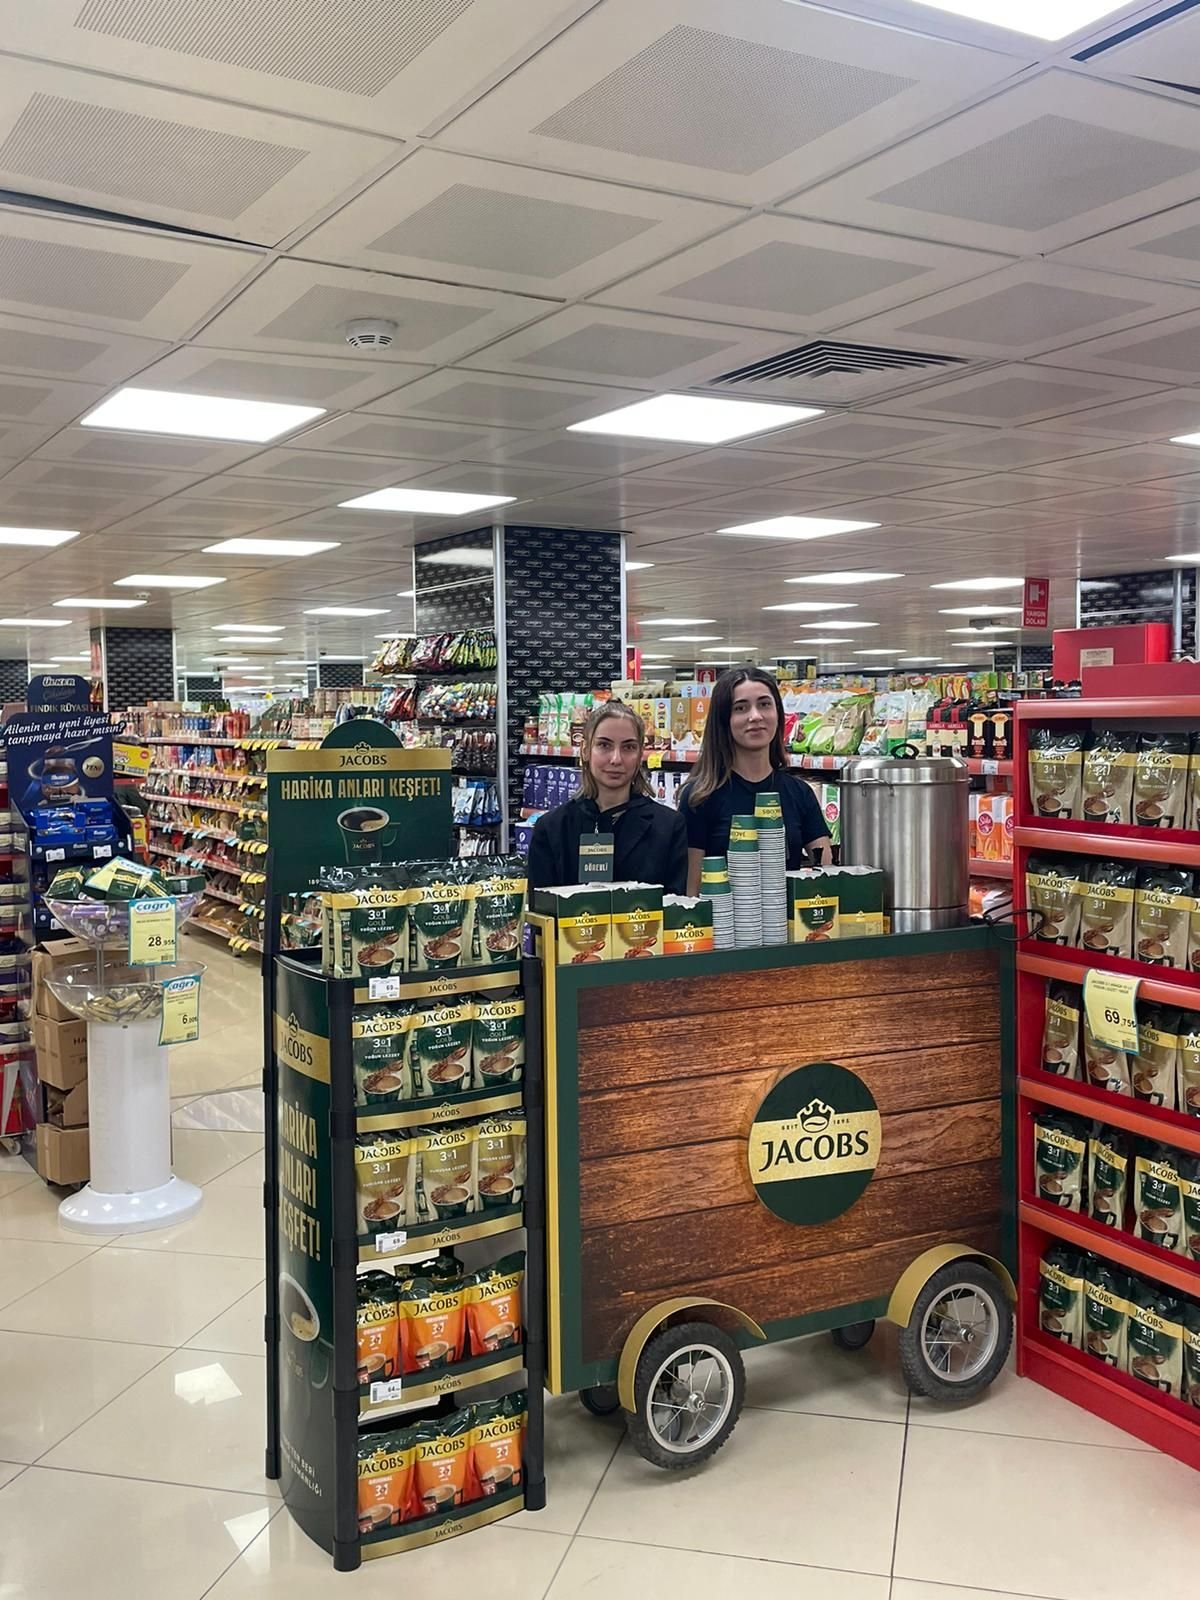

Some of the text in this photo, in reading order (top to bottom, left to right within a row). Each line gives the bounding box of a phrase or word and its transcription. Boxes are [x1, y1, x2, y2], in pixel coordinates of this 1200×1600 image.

[3, 714, 110, 736] Ailenin en yeni üyesi
[8, 732, 61, 747] tanışmaya
[64, 729, 90, 739] hazır
[92, 721, 126, 736] mısın?
[339, 753, 387, 767] JACOBS
[281, 776, 441, 801] HARİKA ANLARI KEŞFET!
[420, 888, 460, 903] JACOBS
[479, 881, 515, 895] JACOBS
[1087, 885, 1117, 899] JACOBS
[355, 893, 399, 906] JACOBS
[674, 930, 704, 940] JACOBS
[428, 981, 457, 993] JACOBS
[421, 1008, 462, 1025] JACOBS
[476, 1004, 517, 1020] JACOBS
[360, 1020, 402, 1036] JACOBS
[1143, 1029, 1160, 1042] COBS
[431, 1107, 460, 1121] JACOBS
[478, 1122, 514, 1136] ACOBS
[1042, 1128, 1071, 1147] JACOBS
[426, 1132, 467, 1149] JACOBS
[360, 1143, 401, 1161] JACOBS
[758, 1129, 870, 1173] JACOBS
[1148, 1162, 1180, 1184] JACOBS
[432, 1231, 461, 1246] JACOBS
[479, 1277, 519, 1300] JACOBS
[1088, 1285, 1114, 1305] JACOBS
[413, 1295, 460, 1316] JACOBS
[1135, 1307, 1165, 1330] JACOBS
[433, 1379, 462, 1394] JACOBS
[478, 1417, 522, 1440] JACOBS
[420, 1437, 466, 1459] JACOBS
[357, 1454, 404, 1477] JACOBS
[434, 1522, 463, 1538] JACOBS
